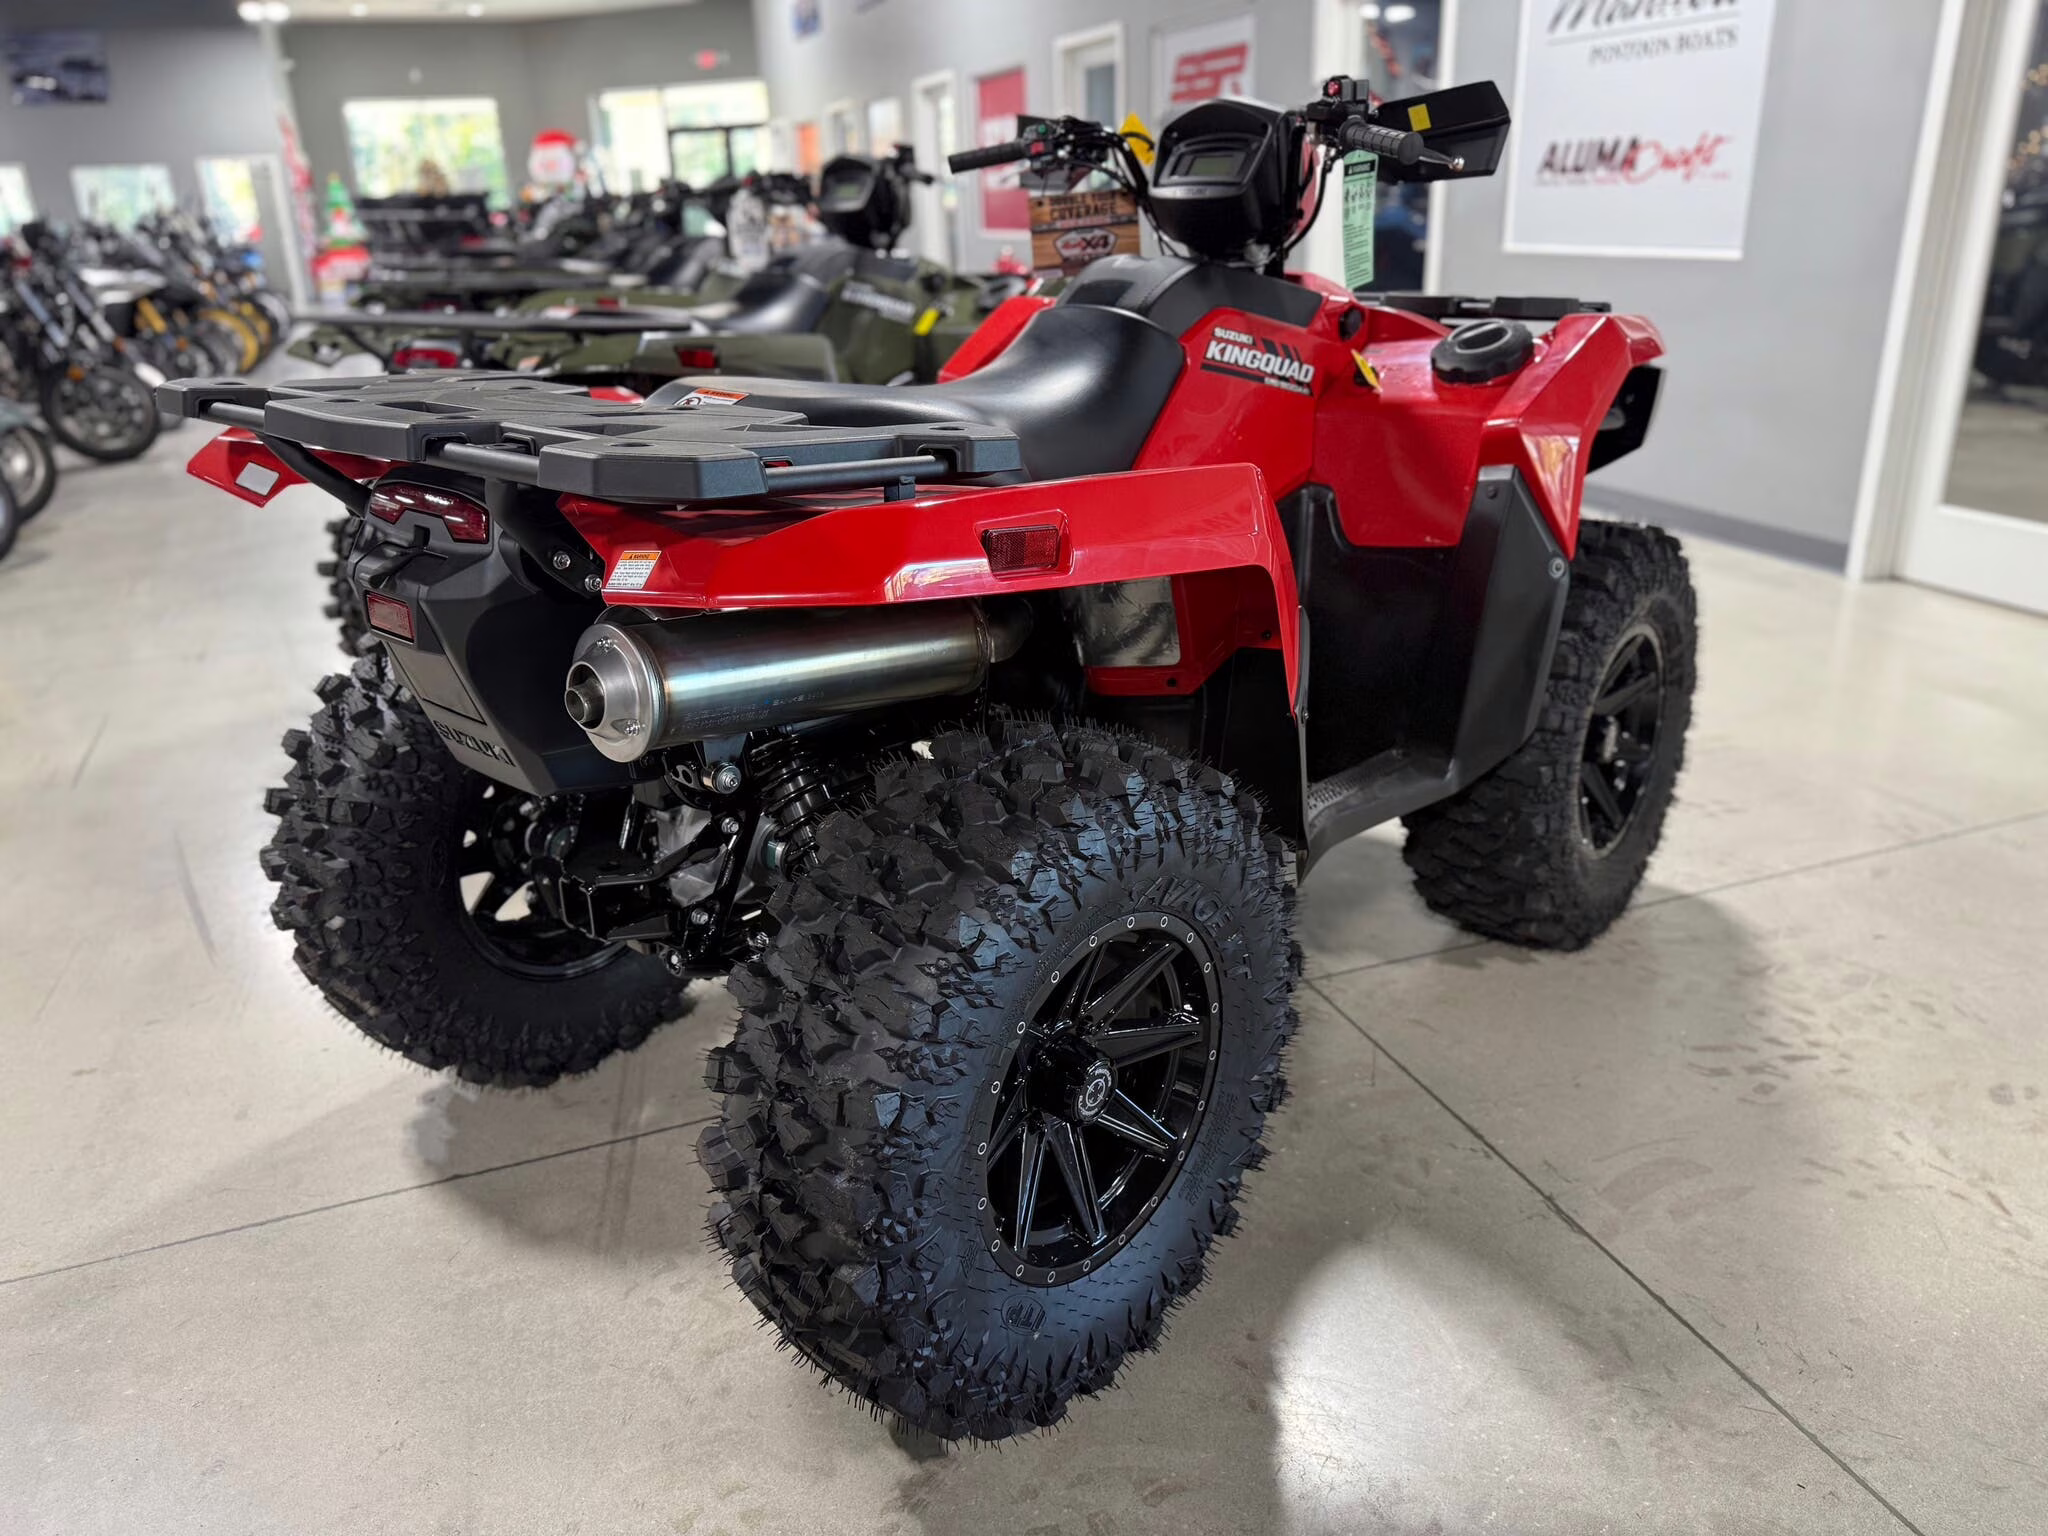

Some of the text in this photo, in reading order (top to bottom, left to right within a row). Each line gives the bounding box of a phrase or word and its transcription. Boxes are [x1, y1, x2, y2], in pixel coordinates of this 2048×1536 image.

[1676, 25, 1738, 54] BOATS
[1050, 202, 1117, 221] COVERAGE
[1213, 326, 1254, 345] SUZUKI
[1205, 340, 1316, 384] KINGQUAD
[433, 720, 516, 768] SUZUKI
